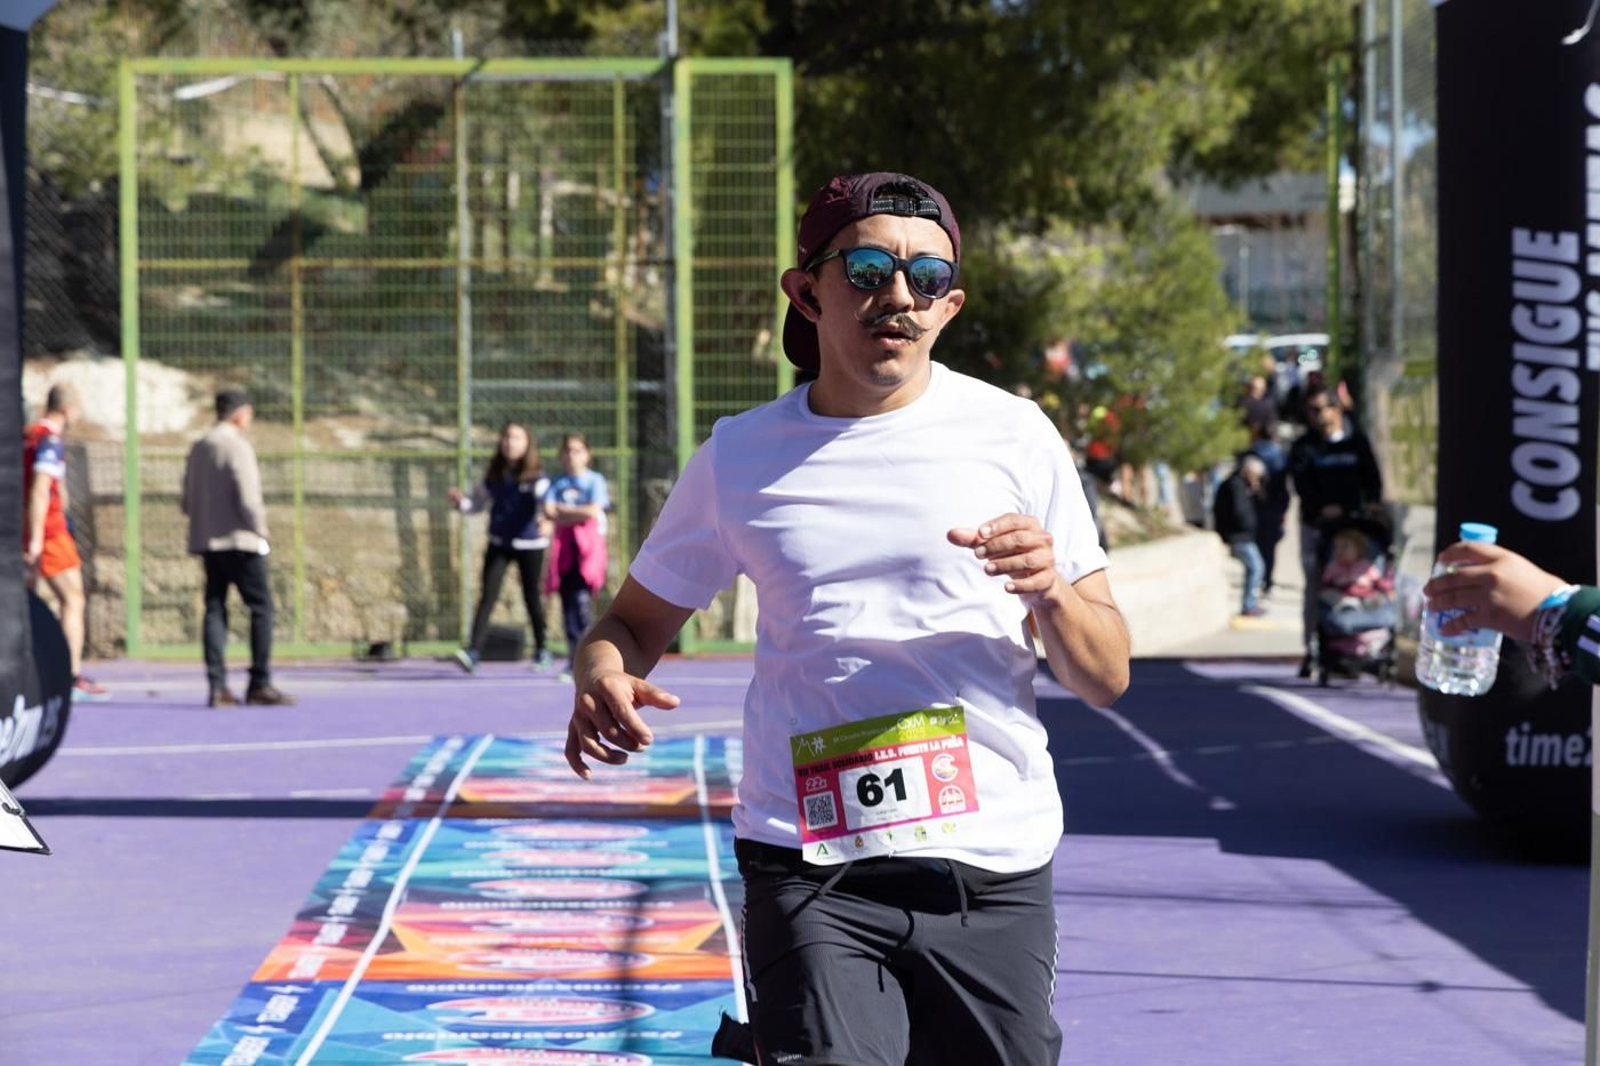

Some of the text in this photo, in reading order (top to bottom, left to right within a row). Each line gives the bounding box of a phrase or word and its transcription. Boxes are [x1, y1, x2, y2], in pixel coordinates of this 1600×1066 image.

[1511, 226, 1582, 522] CONSIGUE
[832, 754, 873, 770] SOLIDARIO
[930, 739, 942, 751] LA
[856, 768, 907, 807] 61
